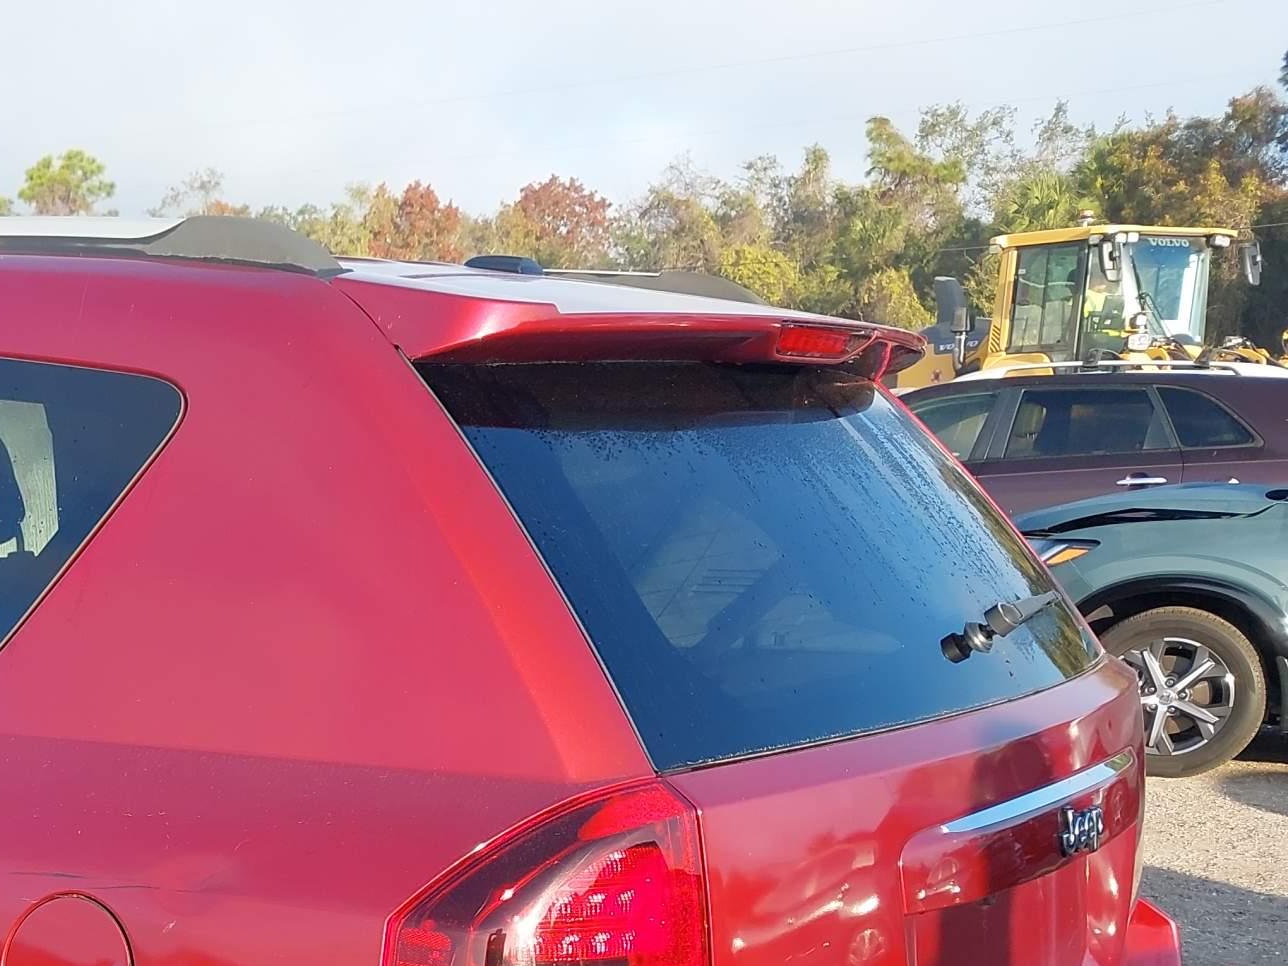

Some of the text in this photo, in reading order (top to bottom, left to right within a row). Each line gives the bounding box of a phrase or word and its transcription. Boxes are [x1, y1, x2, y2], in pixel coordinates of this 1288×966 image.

[1147, 238, 1190, 248] VOLVO
[939, 340, 979, 351] VOVO
[1060, 806, 1104, 857] Jeep
